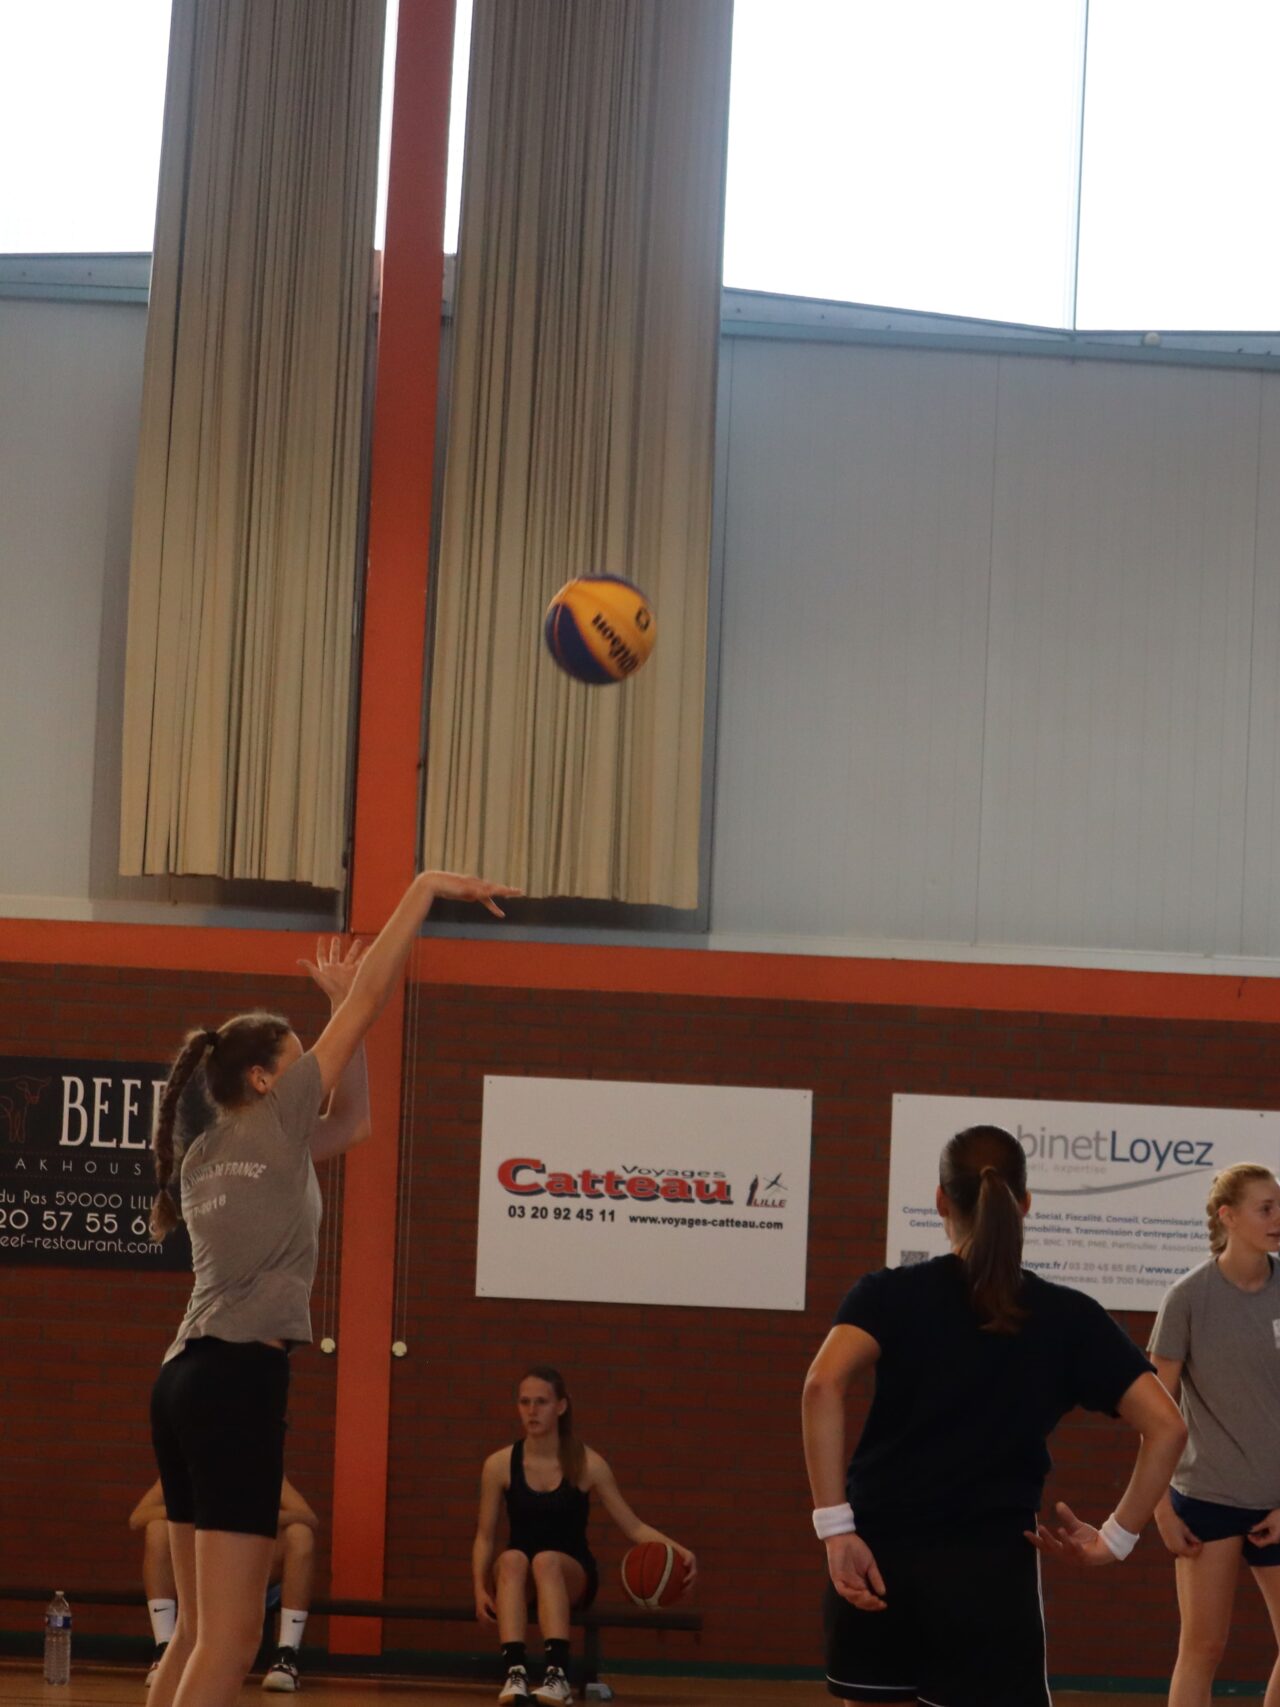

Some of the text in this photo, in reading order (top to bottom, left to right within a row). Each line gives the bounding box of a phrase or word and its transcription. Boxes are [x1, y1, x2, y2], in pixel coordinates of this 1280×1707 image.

[15, 1157, 141, 1176] AKHOUS
[224, 1161, 267, 1179] FRANCE
[622, 1165, 726, 1178] Voyages
[497, 1157, 733, 1205] Catteau
[23, 1190, 47, 1205] Pas
[55, 1191, 123, 1208] 59000
[130, 1195, 156, 1210] LILL
[751, 1198, 787, 1208] LILLE
[508, 1205, 784, 1230] 03 20 92 45 11 www.voyages-catteau.com
[903, 1206, 938, 1216] Compta
[42, 1211, 73, 1232] 57
[85, 1213, 118, 1234] 55
[131, 1215, 155, 1236] 6
[1075, 1226, 1133, 1236] Transmission
[0, 1233, 163, 1254] eef-restaurant.com
